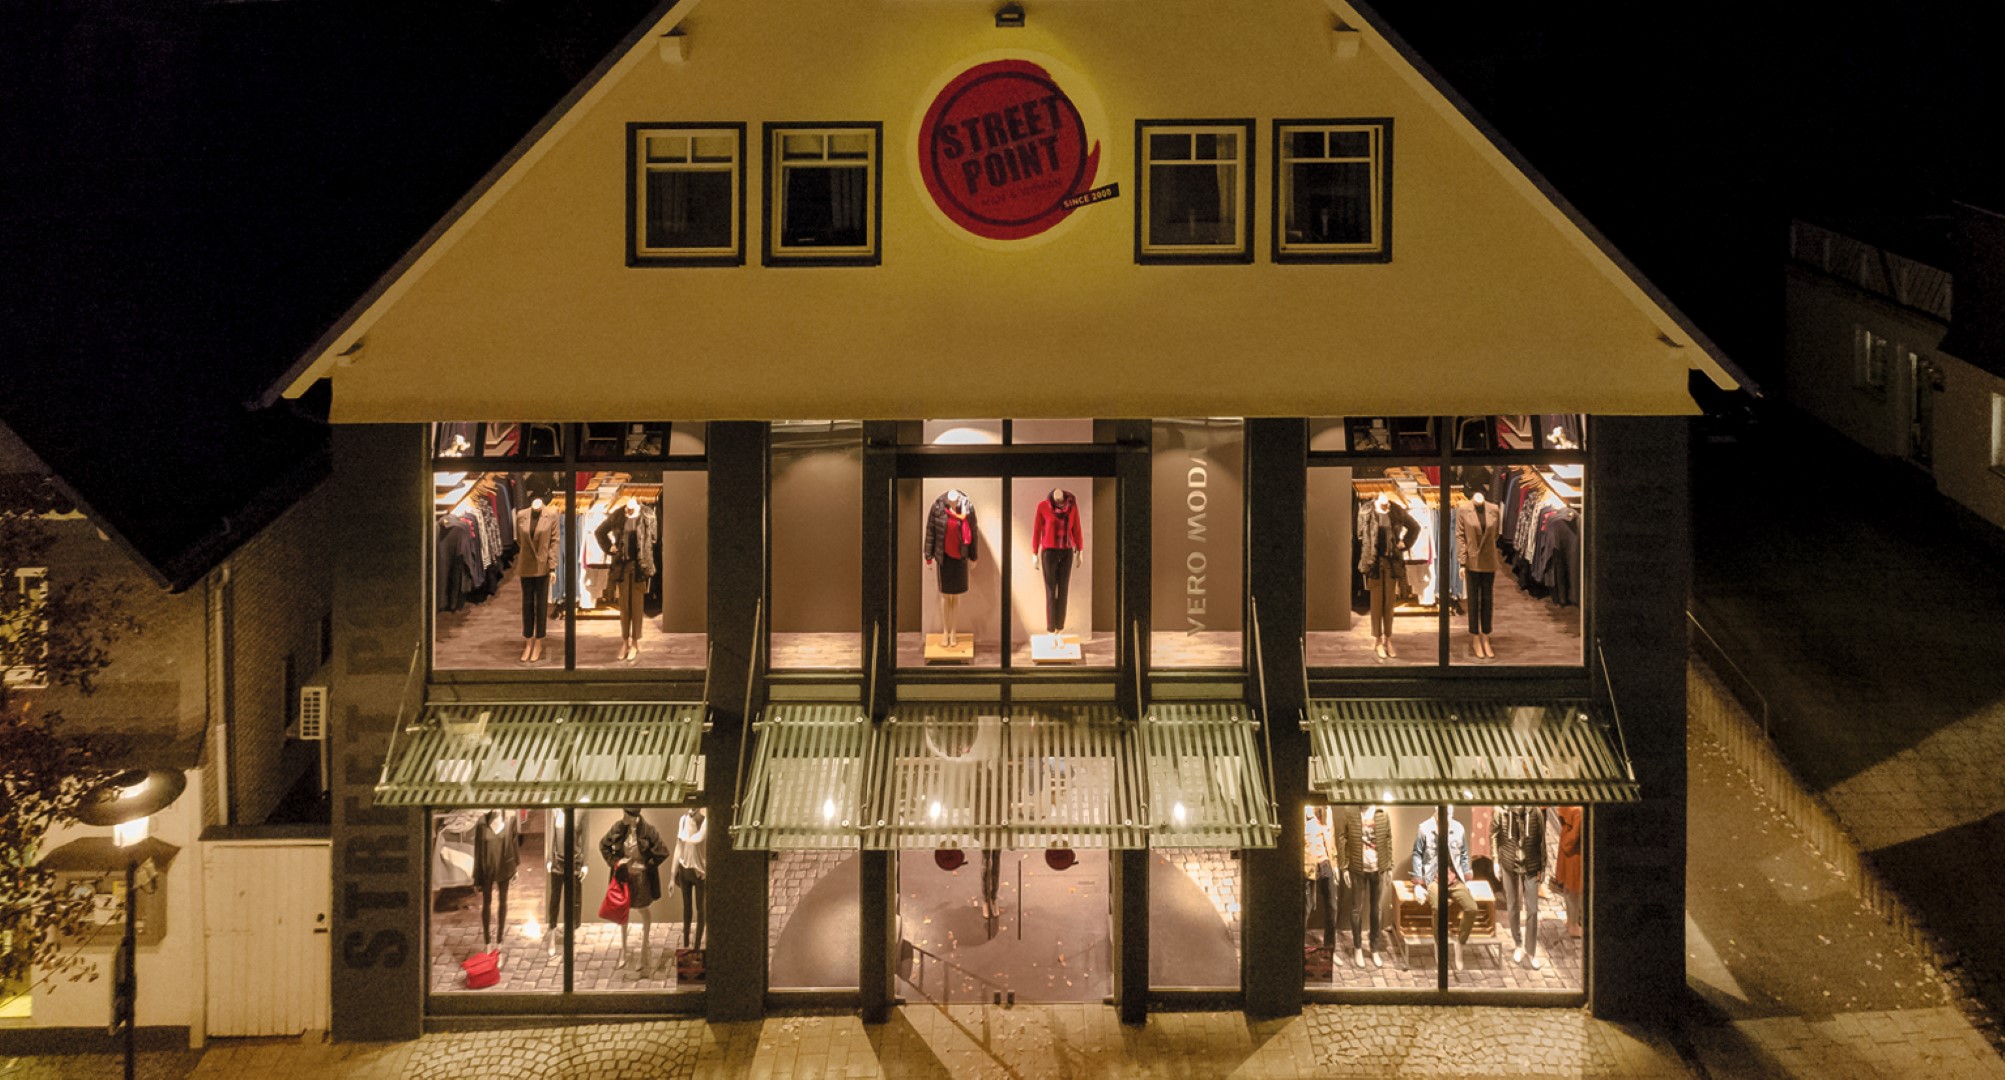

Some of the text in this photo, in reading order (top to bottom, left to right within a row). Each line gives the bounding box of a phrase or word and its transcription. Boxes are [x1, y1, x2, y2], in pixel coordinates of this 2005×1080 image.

[942, 95, 1062, 160] STREET
[961, 136, 1060, 196] POINT
[1063, 193, 1090, 208] SINCE
[1186, 551, 1208, 638] VERO
[343, 704, 409, 969] STREET
